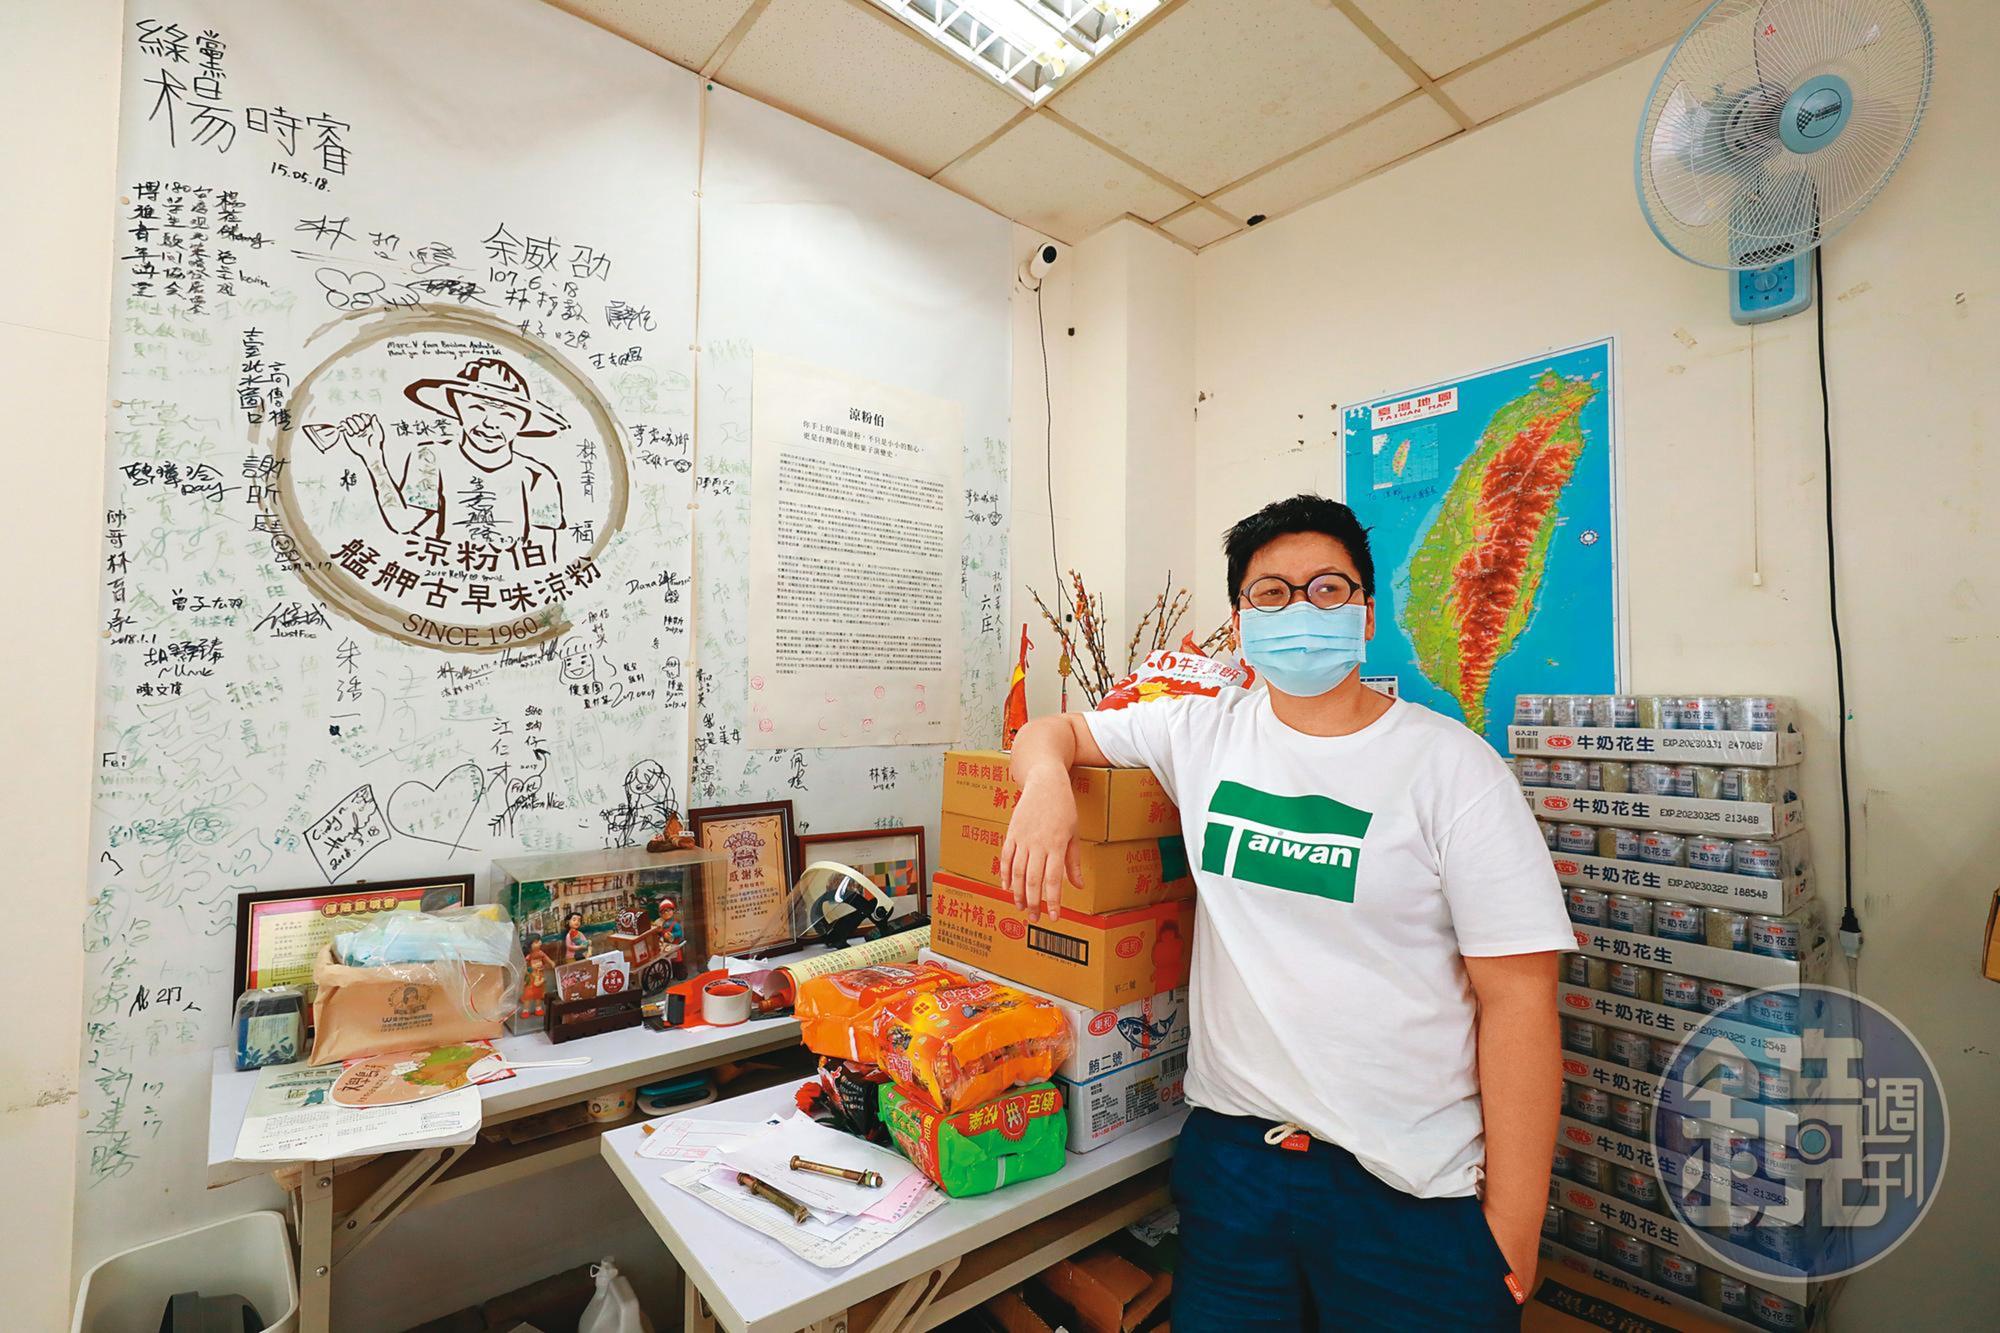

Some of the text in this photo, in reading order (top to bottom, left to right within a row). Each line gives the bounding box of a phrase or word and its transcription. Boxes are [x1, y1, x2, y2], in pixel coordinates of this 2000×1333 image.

[849, 407, 885, 428] 涼粉伯
[1379, 401, 1451, 421] TAIWAN MAP
[405, 537, 547, 572] 涼粉伯
[331, 538, 602, 614] 艋舺古早味涼粉
[403, 613, 539, 647] SINCE 1960
[1577, 734, 1655, 752] 牛奶花生
[1573, 797, 1650, 818] 牛奶花生
[1660, 808, 1760, 825] EXP.20230325 21348B
[1207, 811, 1363, 878] Taiwan
[1583, 864, 1661, 889] 牛奶花生
[1668, 878, 1769, 900] EXP.20230322 18854B
[936, 894, 998, 932] 蕃茄汁鯖魚
[1593, 936, 1673, 964] 牛奶花生
[1595, 999, 1676, 1032] 牛奶花生
[1593, 1067, 1673, 1104] 牛奶花生
[1597, 1135, 1678, 1176] 牛奶花生
[1600, 1201, 1680, 1247] 牛奶花生
